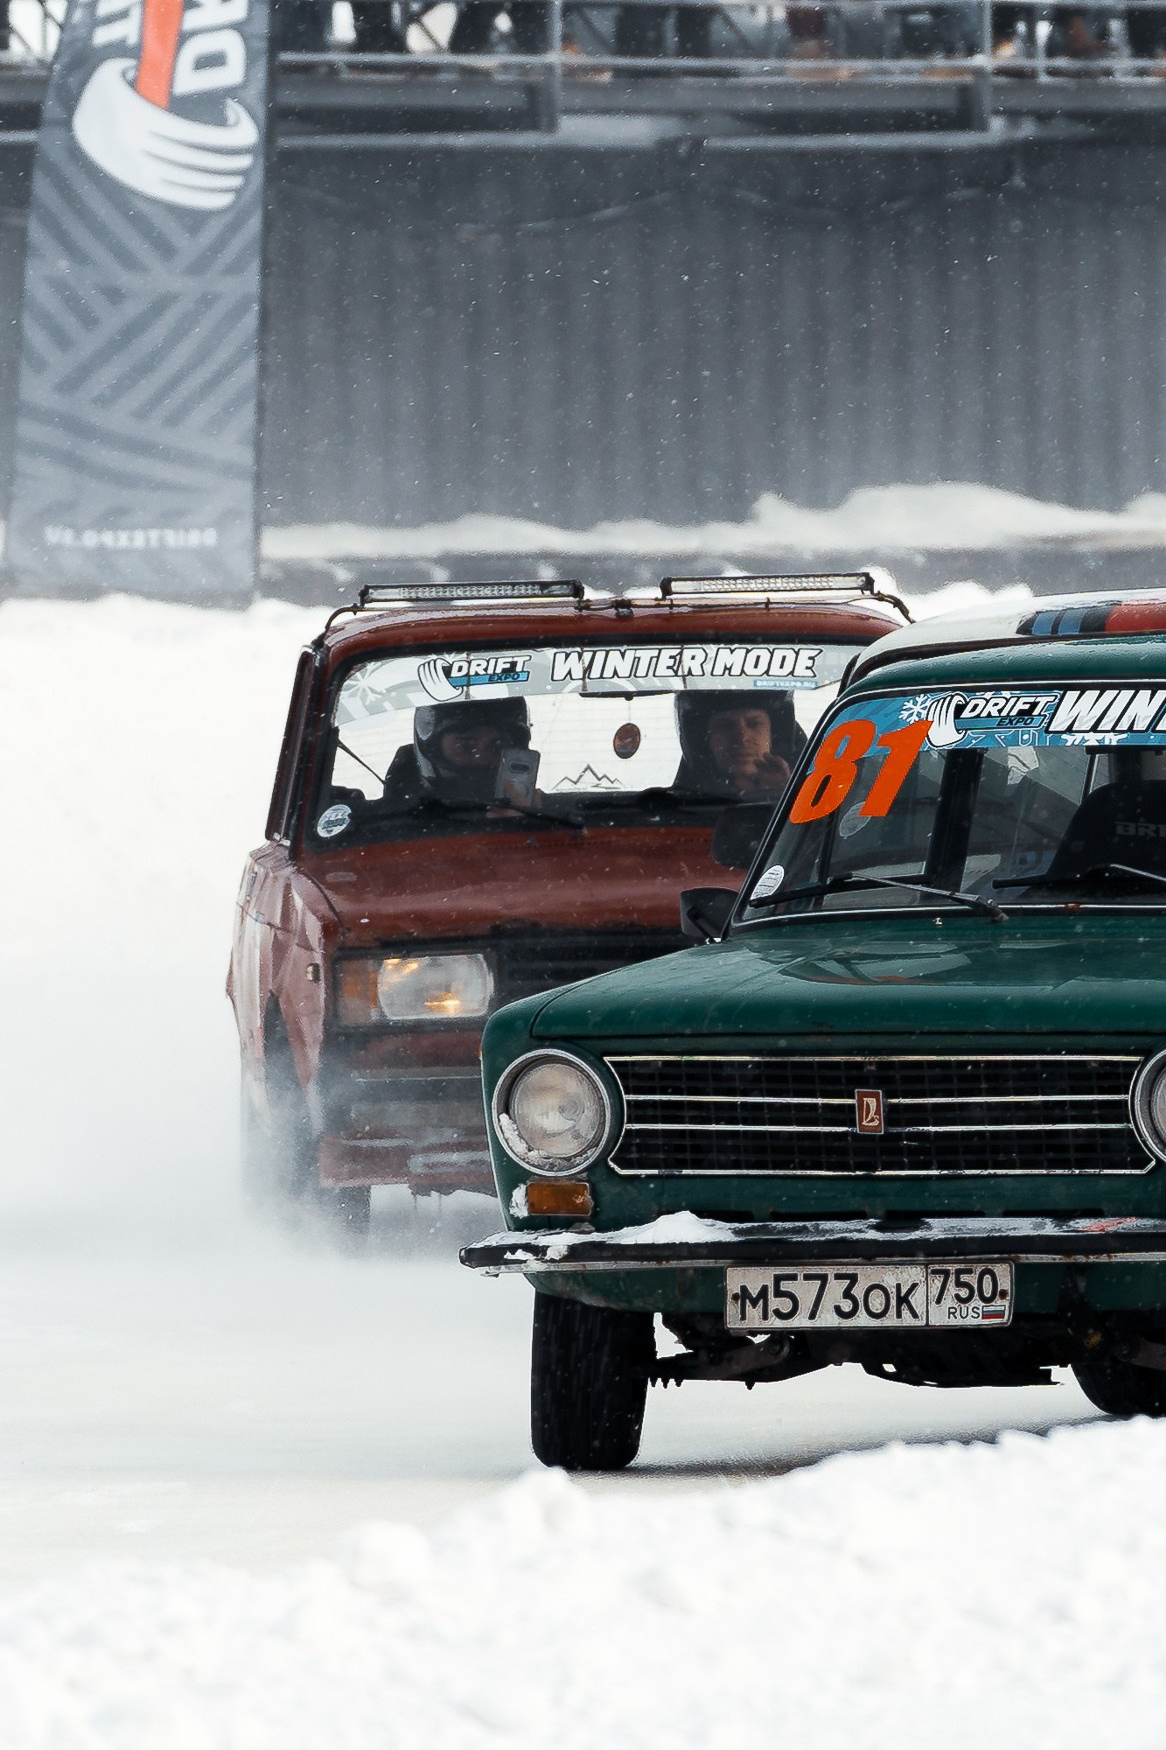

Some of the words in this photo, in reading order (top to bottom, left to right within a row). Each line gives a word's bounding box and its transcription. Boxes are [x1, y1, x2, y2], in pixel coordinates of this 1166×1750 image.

[450, 654, 532, 677] DRIFT
[552, 648, 706, 682] WINTER
[712, 647, 823, 678] MODE
[488, 672, 521, 683] EXPO
[960, 695, 1056, 718] DRIFT
[998, 717, 1035, 728] EXPO
[790, 719, 934, 825] 81
[930, 1267, 999, 1306] 750
[947, 1305, 981, 1321] RUS
